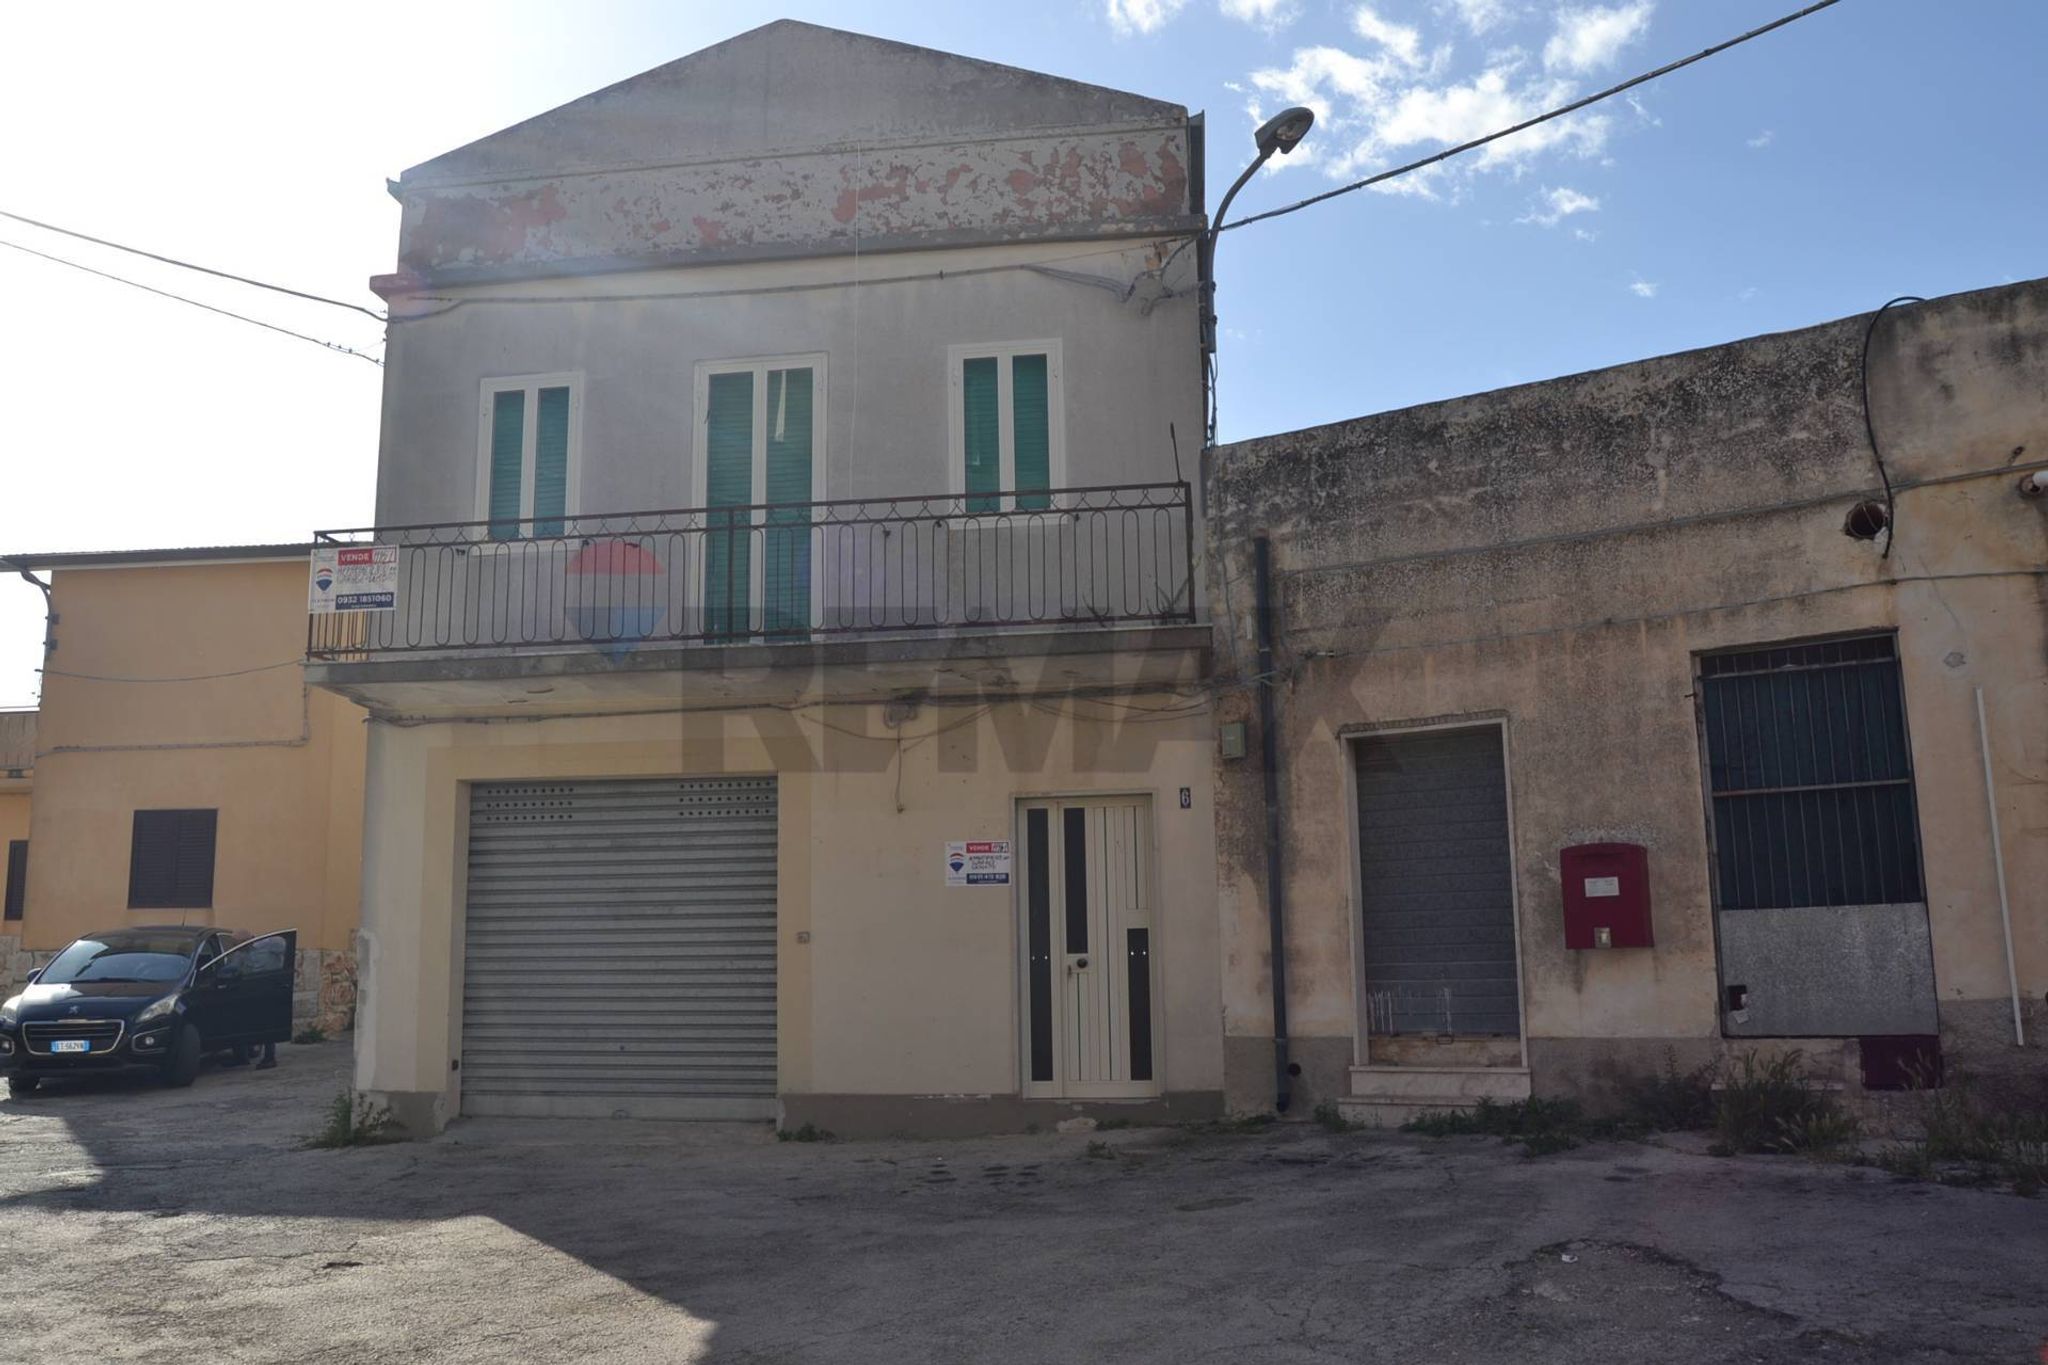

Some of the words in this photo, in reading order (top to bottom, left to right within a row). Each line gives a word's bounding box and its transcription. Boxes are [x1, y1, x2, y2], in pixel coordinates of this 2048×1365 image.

[341, 553, 370, 561] VENDE
[337, 595, 358, 604] 0932
[1181, 789, 1190, 807] 6
